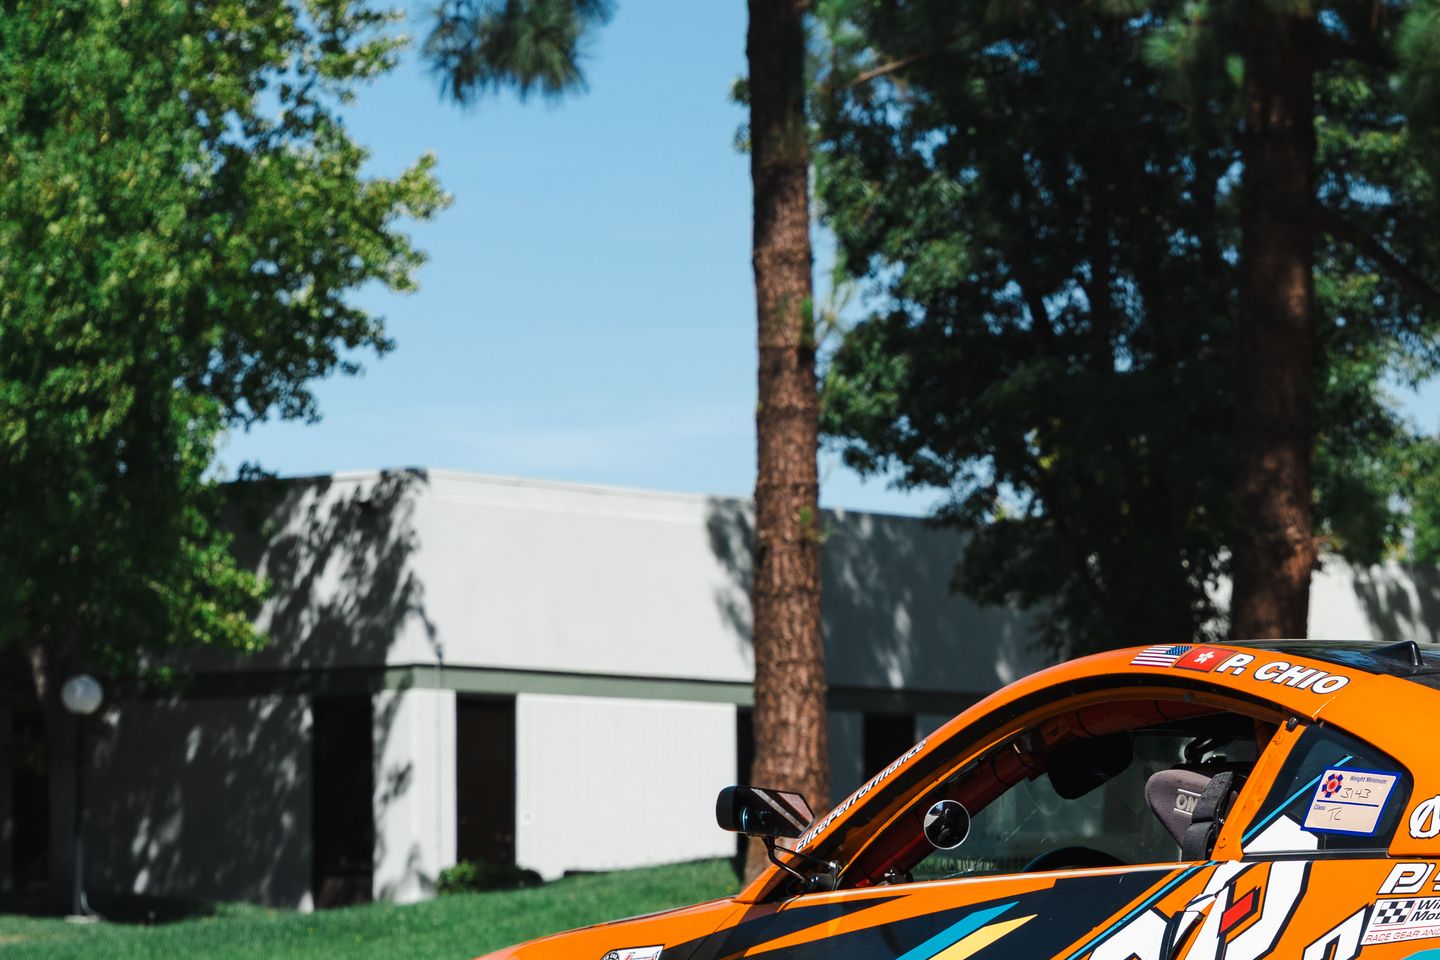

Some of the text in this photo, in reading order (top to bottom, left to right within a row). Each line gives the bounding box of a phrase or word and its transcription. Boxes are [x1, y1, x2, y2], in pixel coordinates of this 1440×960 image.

[1214, 652, 1351, 695] P. CHIO
[1350, 775, 1388, 785] Weight Minimum
[1340, 787, 1371, 799] 3143
[1327, 807, 1342, 822] TC
[1365, 932, 1391, 943] RACE
[1393, 930, 1419, 940] GEAR
